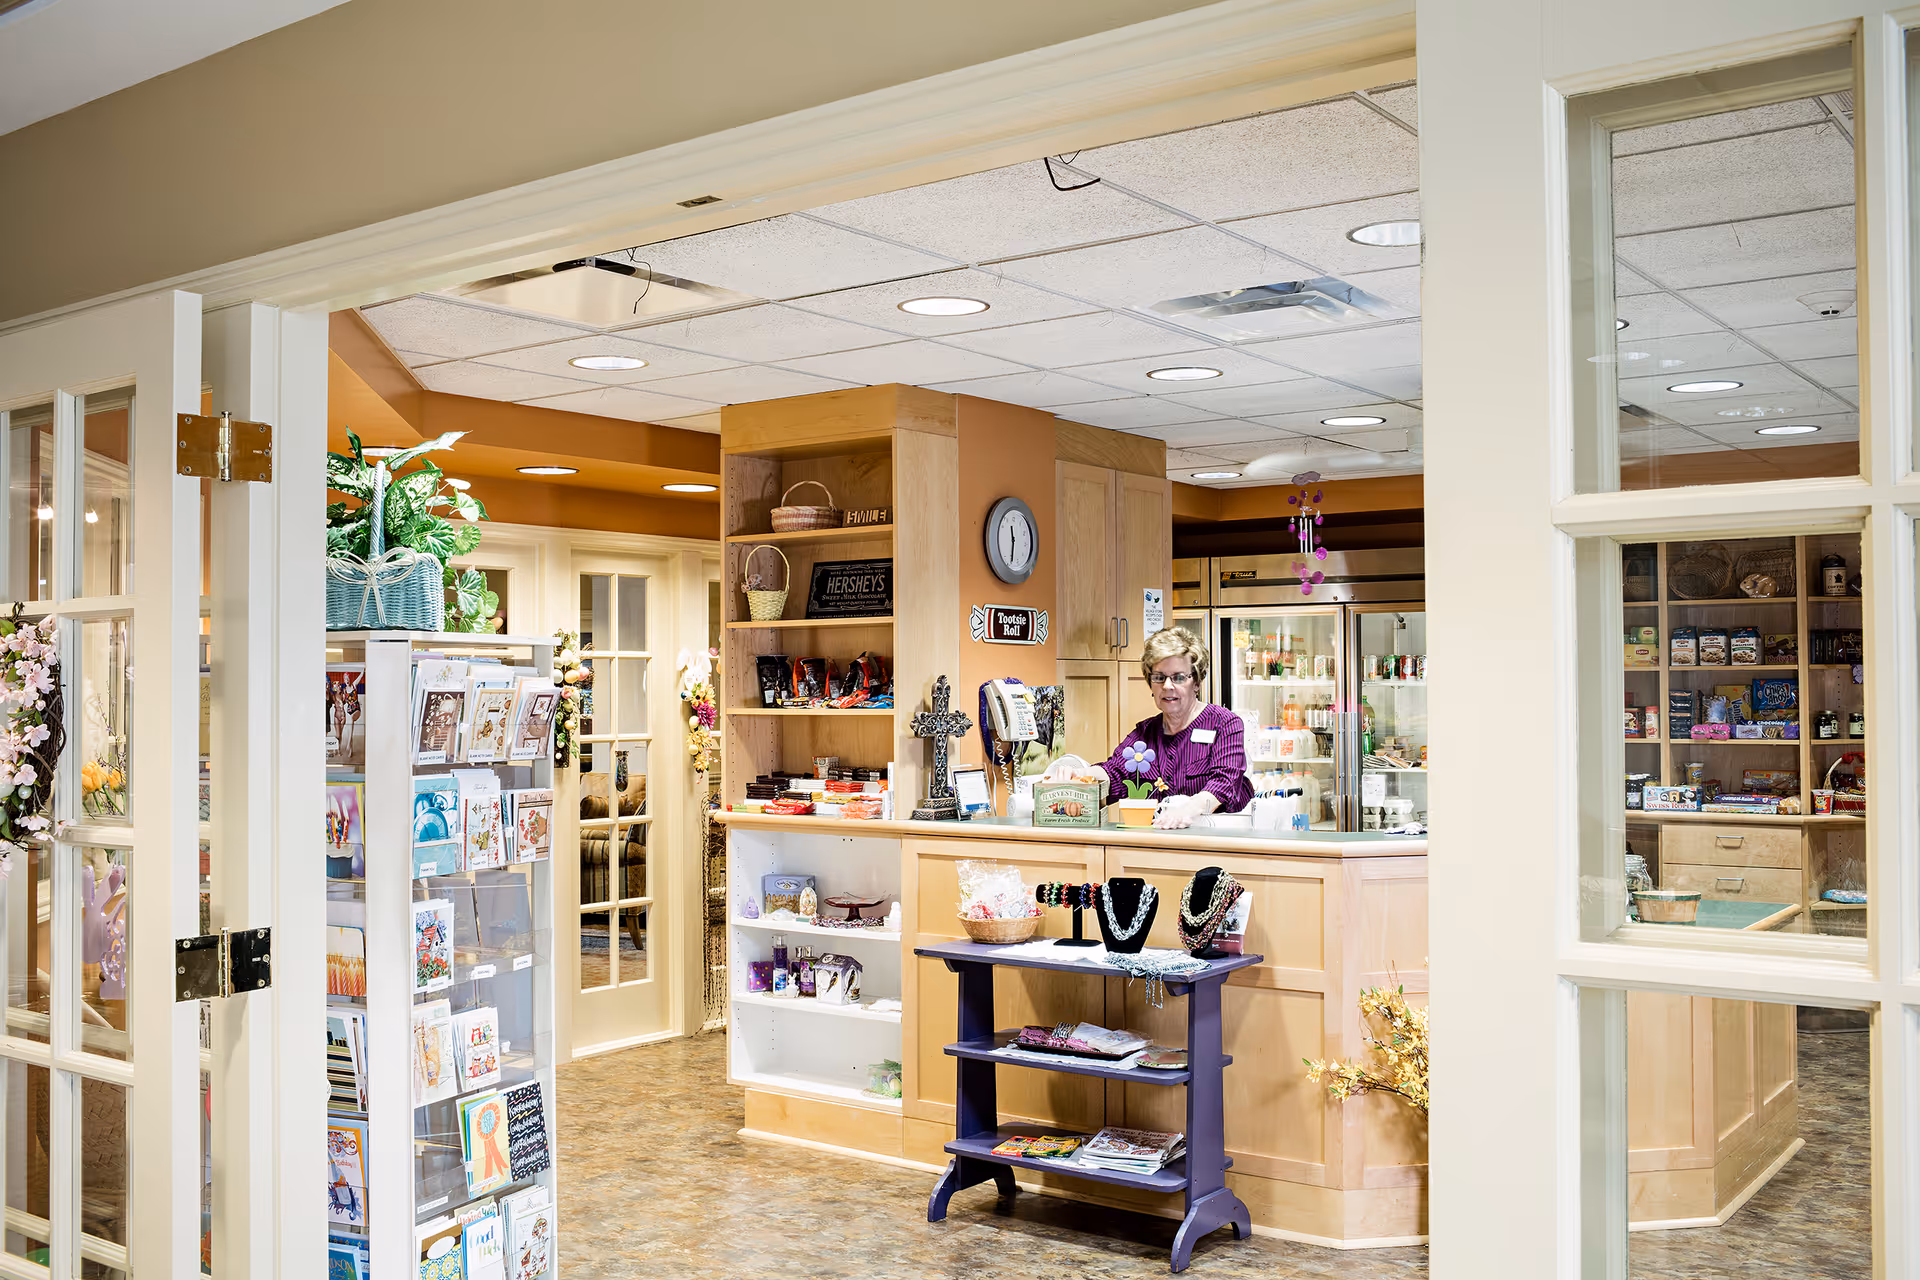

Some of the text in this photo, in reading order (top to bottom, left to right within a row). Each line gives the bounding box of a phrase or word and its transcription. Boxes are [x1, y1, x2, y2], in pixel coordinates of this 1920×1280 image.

[846, 509, 887, 524] SMILE
[826, 573, 886, 594] HERSHEY'S
[997, 612, 1027, 625] Tootsie
[1003, 624, 1021, 637] Roll
[1764, 685, 1786, 697] Chips
[1042, 790, 1073, 800] HARVEST
